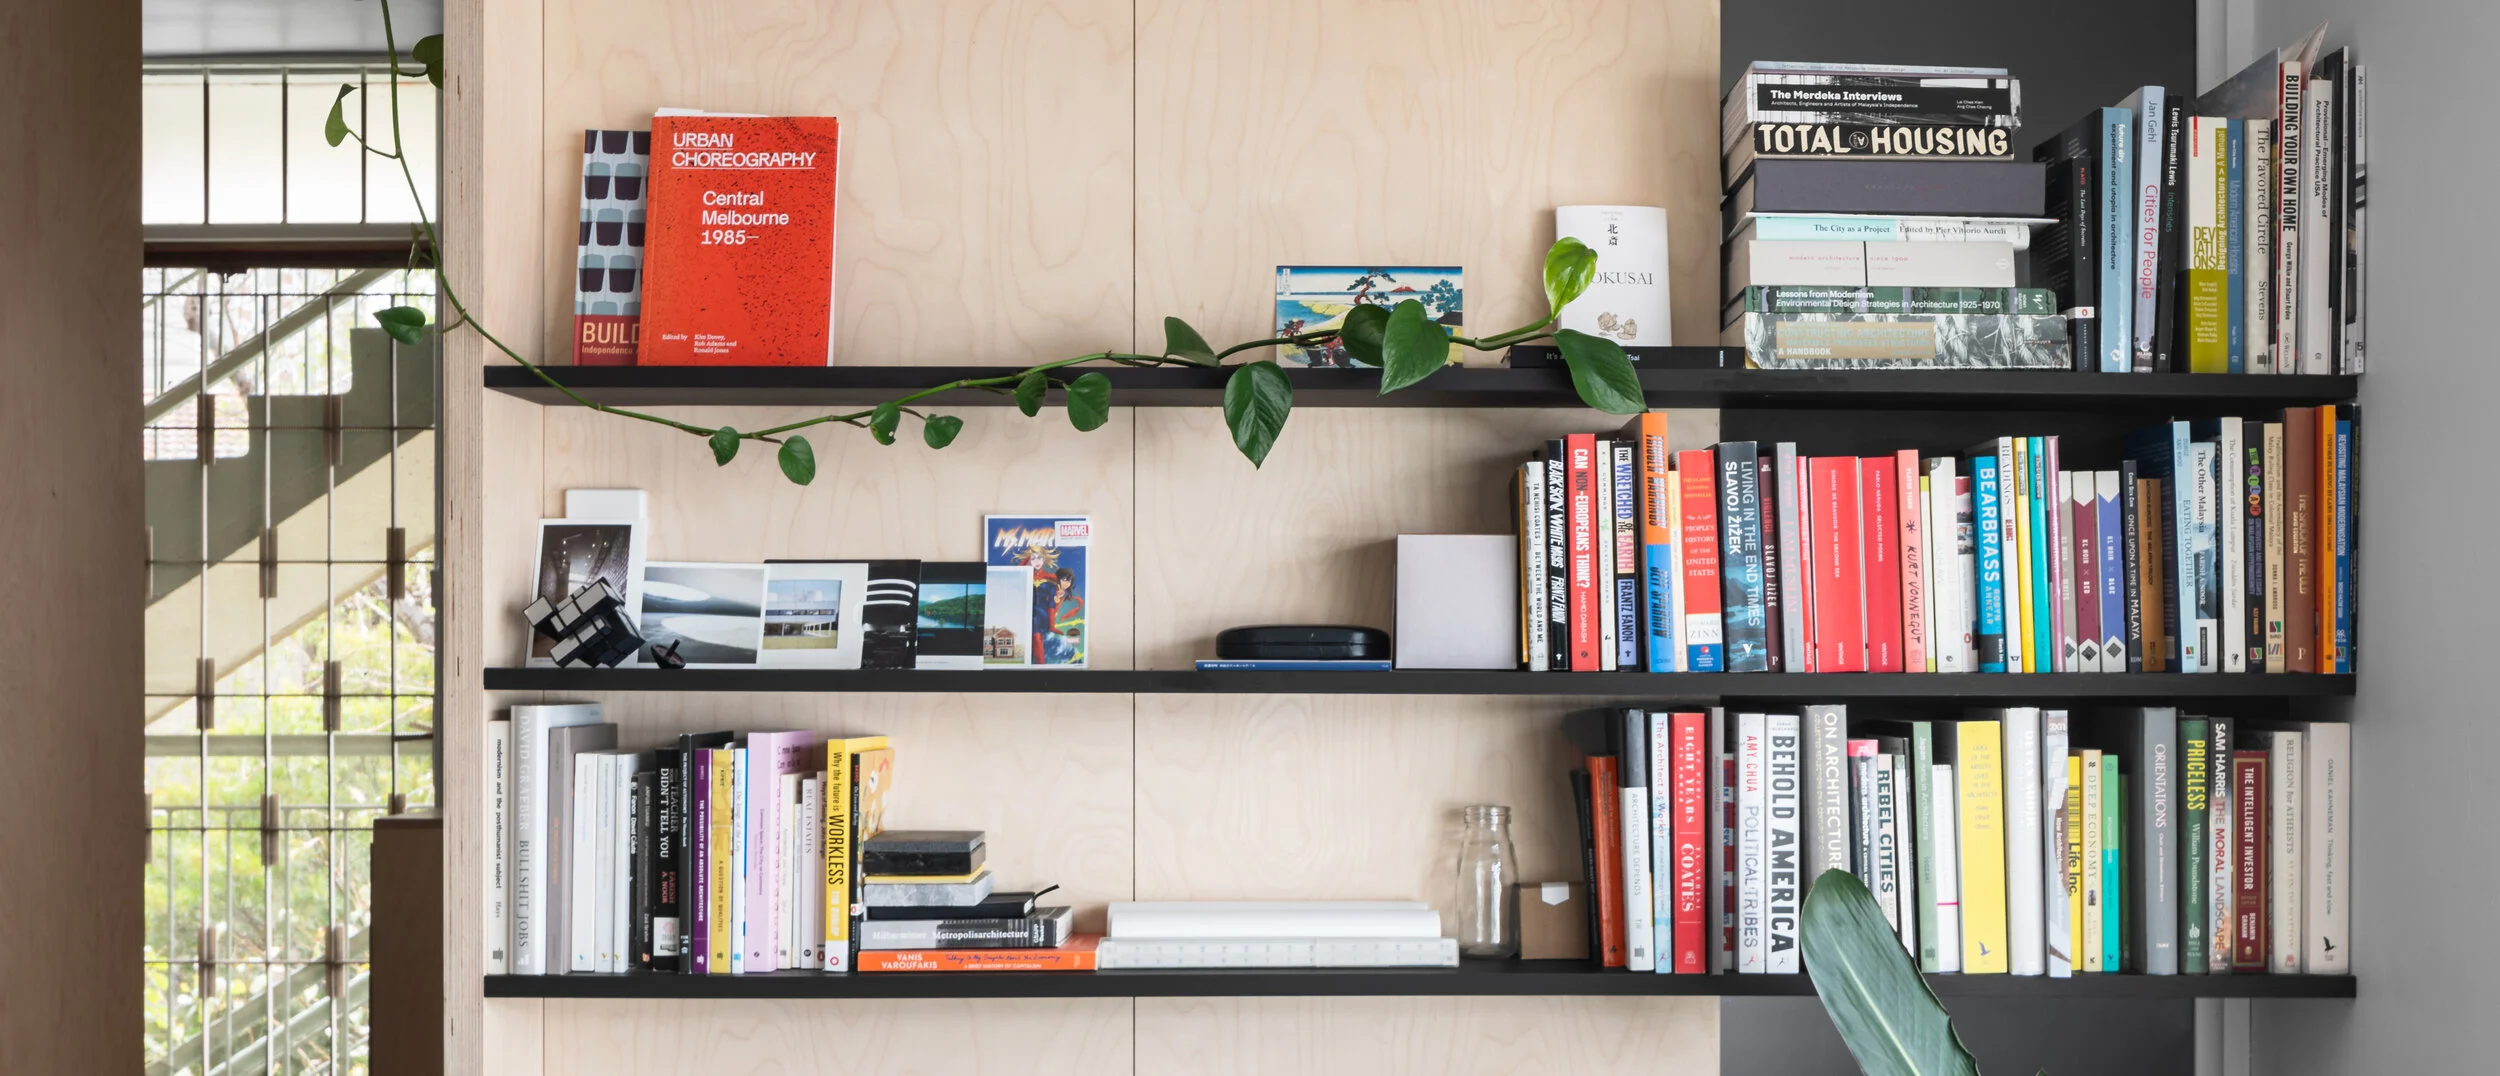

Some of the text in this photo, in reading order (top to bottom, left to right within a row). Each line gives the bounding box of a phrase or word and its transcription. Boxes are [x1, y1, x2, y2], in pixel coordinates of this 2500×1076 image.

[1771, 90, 1902, 101] The Merdeka Interviews
[672, 152, 815, 166] CHOREOGRAPHY
[673, 133, 733, 147] URBAN
[1758, 124, 2007, 155] TOTAL HOUSING
[2283, 75, 2299, 231] BUILDING YOUR OWN HOME
[2166, 108, 2180, 232] Lewis Tsurumaki Lewis Intensities
[702, 210, 789, 225] Melbourne
[703, 190, 763, 205] Central
[2140, 100, 2158, 298] Jan Gehl Cities for People
[1831, 225, 1845, 233] City
[1864, 225, 1890, 234] Project
[2217, 178, 2226, 270] Designing Architecture
[2258, 129, 2269, 320] The Favored Circle Stevens
[1809, 290, 1828, 298] from
[1833, 301, 1860, 309] Design
[1861, 301, 1900, 309] Strategies
[1575, 449, 1588, 468] CAN
[1619, 449, 1628, 461] THE
[1576, 472, 1590, 550] NON-EUROPEANS
[1617, 464, 1632, 519] WRETCHED
[1726, 461, 1741, 554] SLAVOJ ŽIŽEK
[2197, 451, 2207, 533] The Other Malaysia
[1060, 525, 1088, 536] MARVEL
[1618, 522, 1626, 533] THE
[1741, 461, 1760, 625] LIVING IN THE END TIMES
[1980, 468, 2000, 582] BEARBRASS
[2183, 500, 2193, 587] EATING TOGETHER
[1577, 554, 1590, 587] THINK?
[1618, 535, 1633, 569] EARTH
[1621, 581, 1633, 612] FRANTZ
[1906, 546, 1921, 643] KURT VONNEGUT
[1622, 615, 1633, 642] FANON
[2131, 600, 2139, 640] MALAYA
[831, 752, 842, 768] Why
[2187, 740, 2205, 810] PRICELESS
[670, 786, 678, 832] TEACHER
[833, 783, 841, 803] future
[1824, 713, 1842, 870] ON ARCHITECTURE
[2154, 744, 2166, 828] ORIENTATIONS
[2286, 739, 2294, 853] RELIGION for ATHEISTS
[517, 715, 530, 947] DAVID GRAEBER BULLSHIT JOBS
[660, 808, 668, 833] TELL
[1681, 727, 1694, 912] EIGHT YEARS COATES
[1744, 736, 1759, 947] AMY CHUA POLITICAL TRIBES
[1771, 736, 1795, 952] BEHOLD AMERICA
[1878, 770, 1893, 892] REBEL CITIES
[2215, 723, 2225, 949] SAM HARRIS THE MORAL LANDSCAPE
[2244, 768, 2254, 889] THE INTELLIGENT INVESTOR
[660, 836, 668, 857] YOU
[828, 814, 844, 885] WORKLESS
[2068, 843, 2080, 896] Life Inc.
[2191, 856, 2199, 904] Poundstone
[932, 931, 1029, 939] Metropolisarchitecture
[882, 961, 937, 969] VAROUFAKIS
